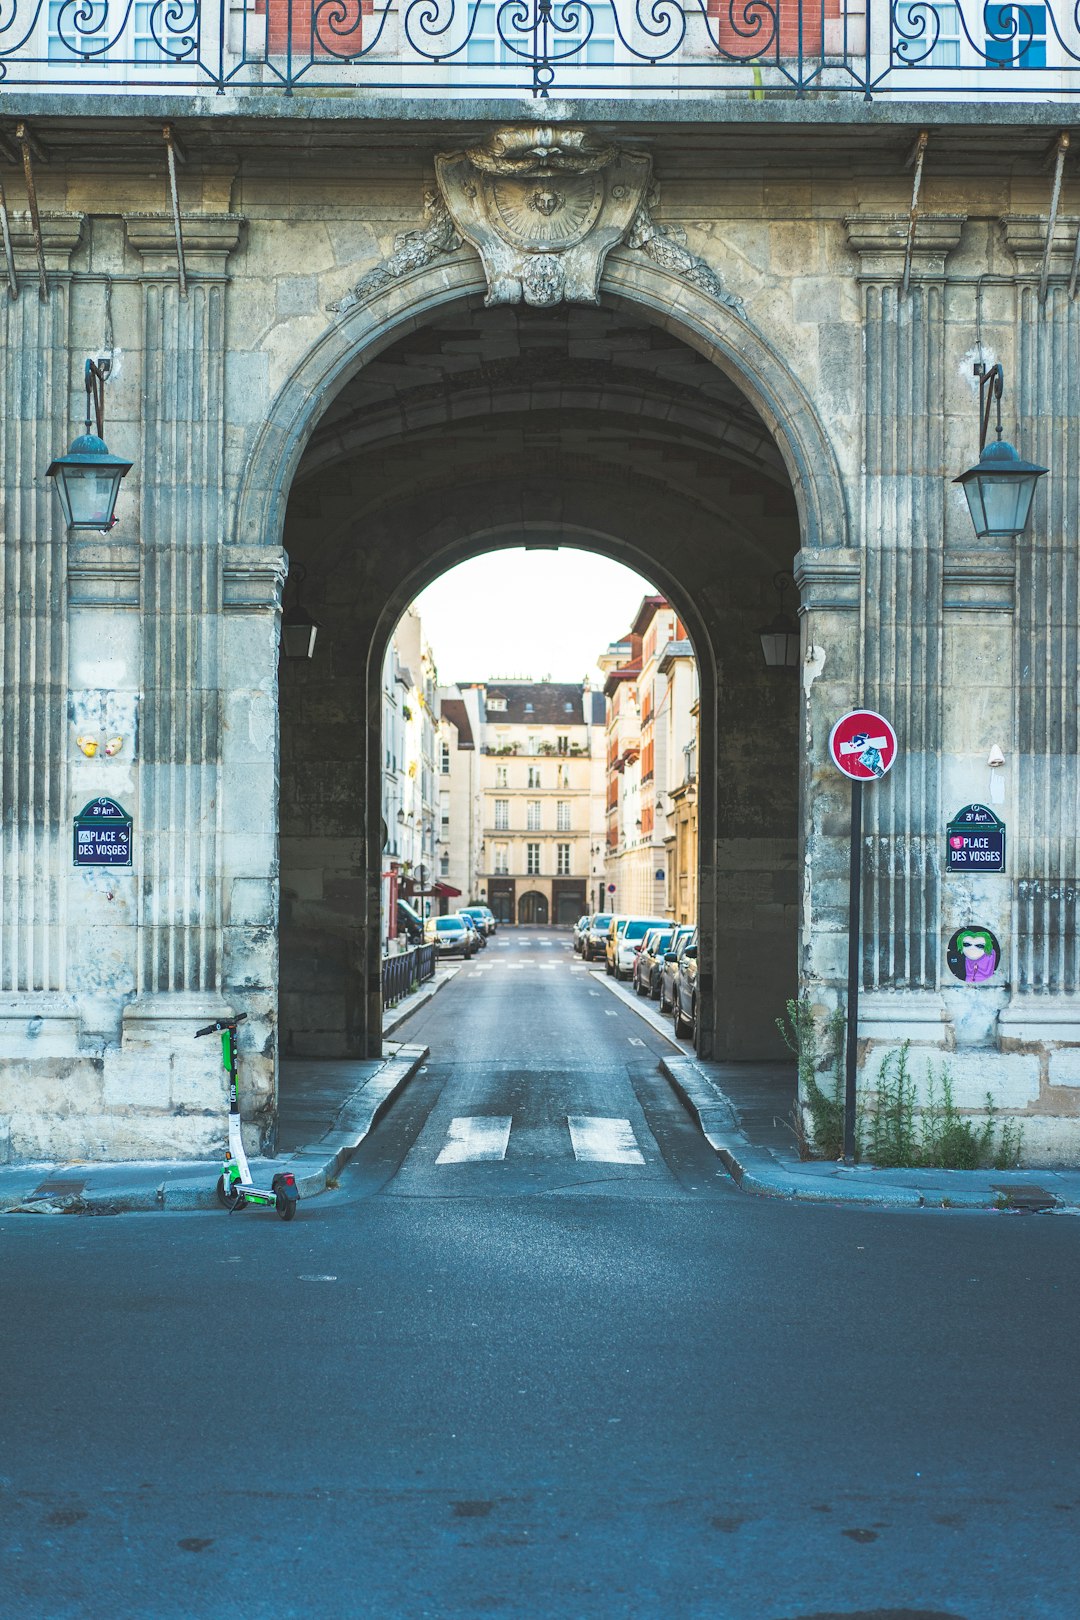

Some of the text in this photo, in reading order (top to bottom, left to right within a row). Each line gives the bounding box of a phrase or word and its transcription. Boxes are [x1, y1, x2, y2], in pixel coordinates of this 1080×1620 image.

[90, 831, 116, 842] PLACE
[963, 838, 989, 848] PLACE
[78, 845, 127, 855] DES VOSGES
[951, 851, 1000, 861] DES VOSGES
